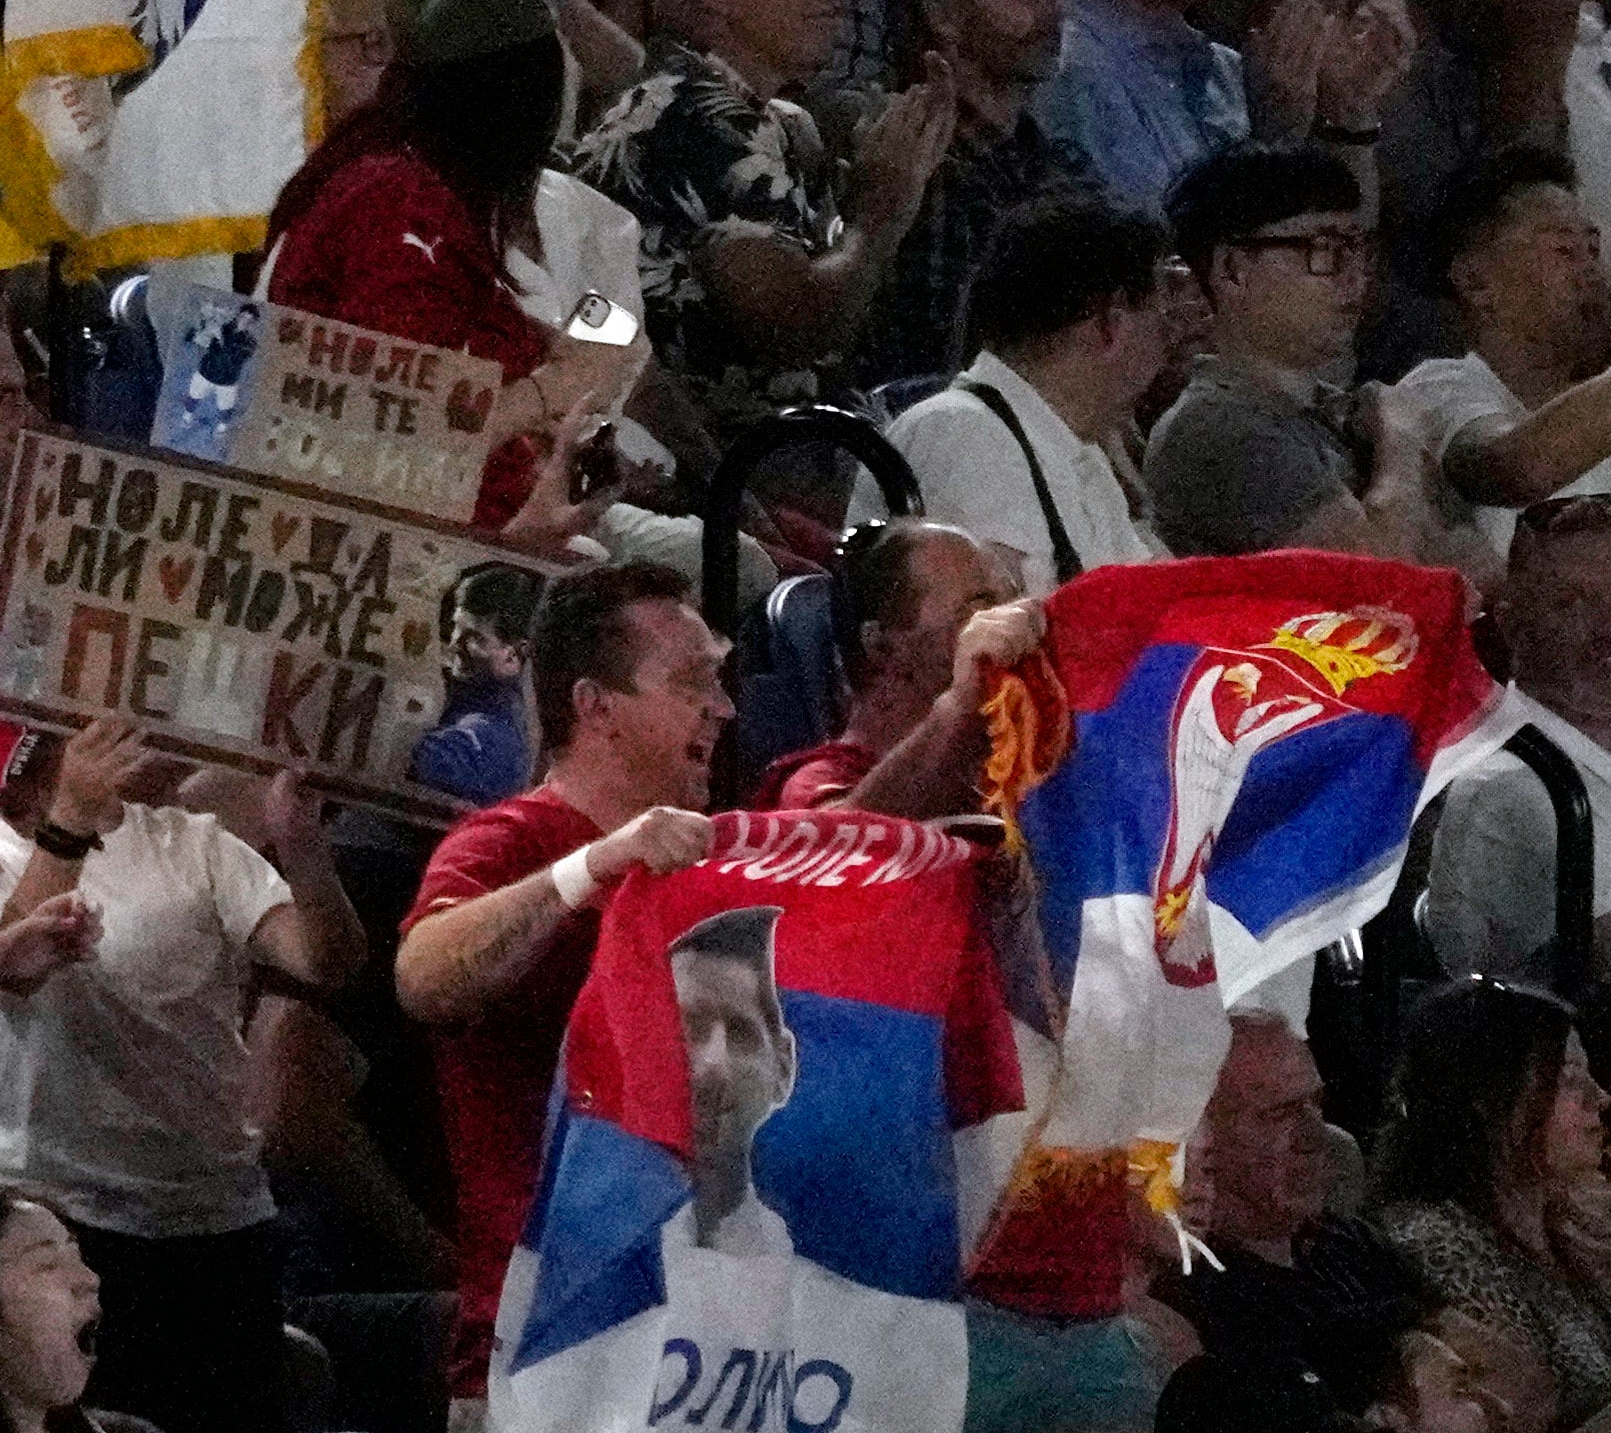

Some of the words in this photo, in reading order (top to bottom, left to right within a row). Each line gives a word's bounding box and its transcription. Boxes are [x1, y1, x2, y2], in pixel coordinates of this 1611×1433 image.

[57, 452, 262, 562] НОЛЕ
[44, 524, 151, 603] ЛИ
[194, 556, 398, 668] МОЖЕ
